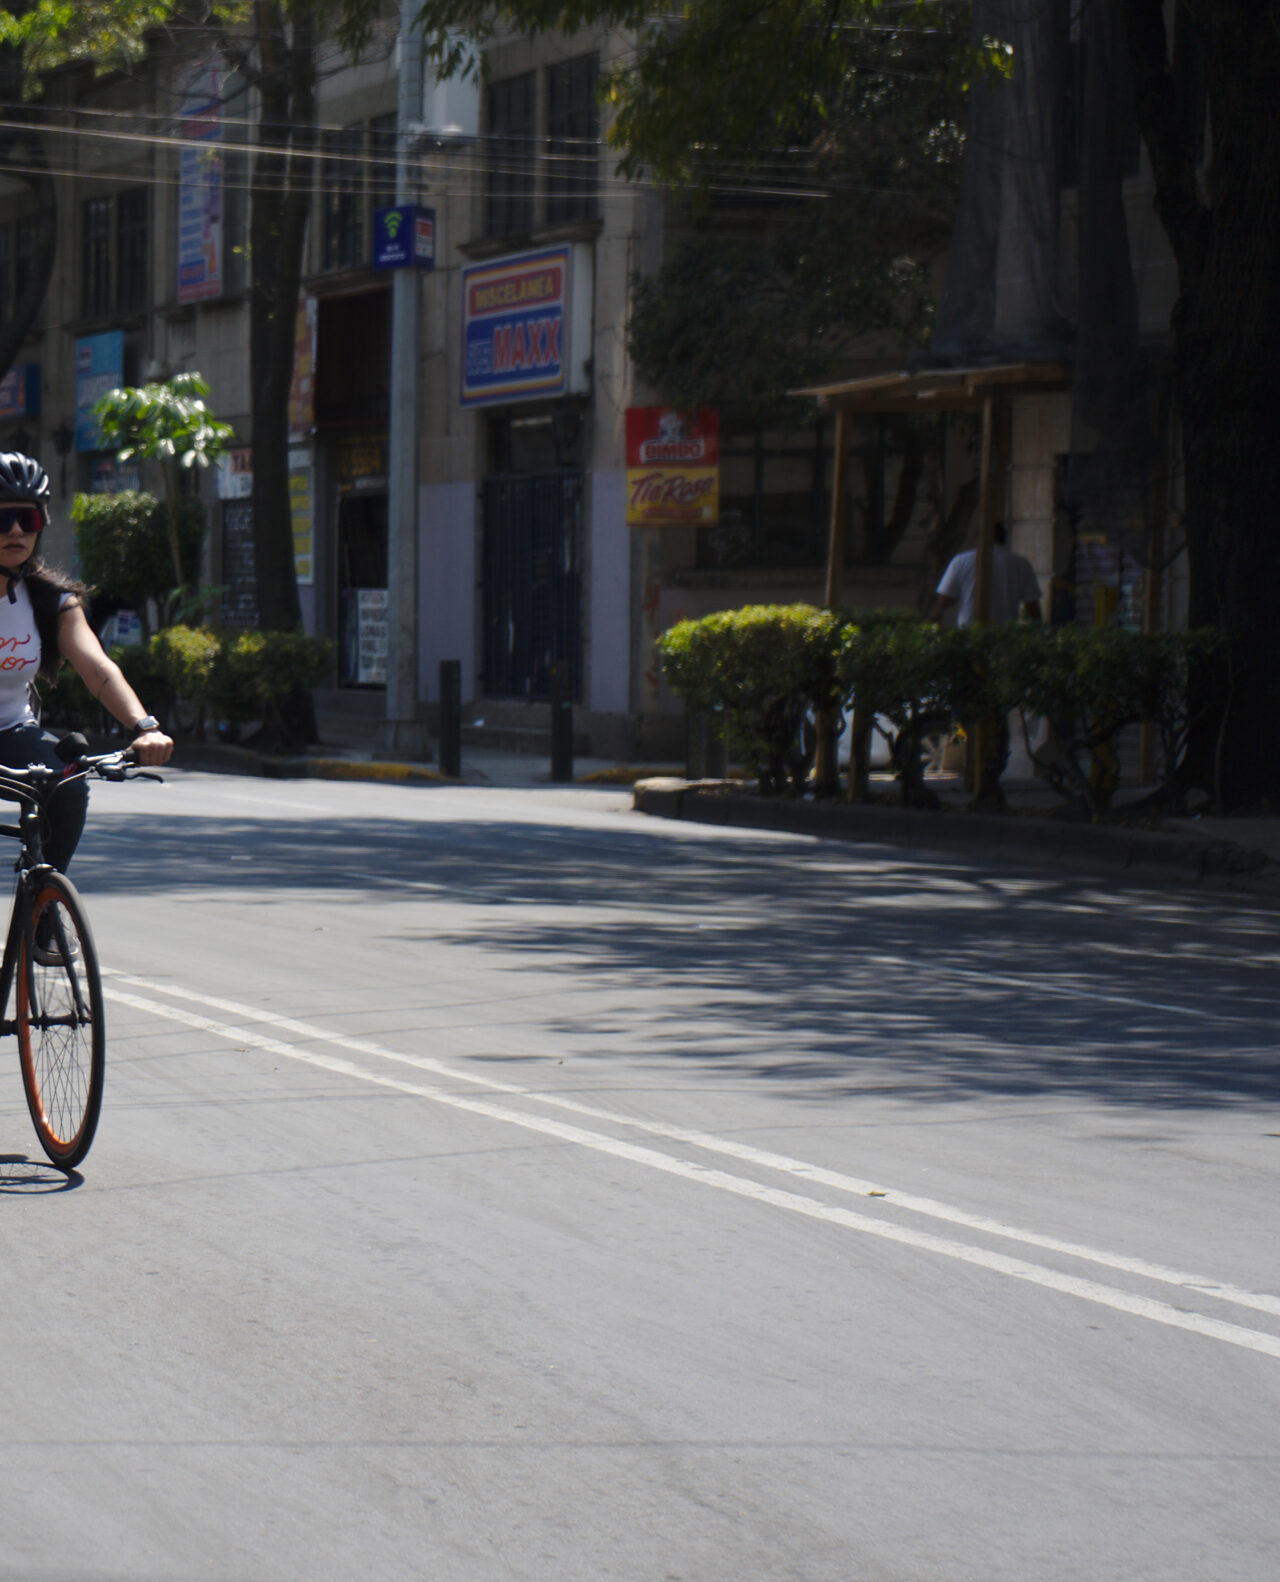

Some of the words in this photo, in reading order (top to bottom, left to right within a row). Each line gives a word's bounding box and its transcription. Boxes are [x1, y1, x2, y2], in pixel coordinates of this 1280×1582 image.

[474, 272, 554, 311] MISCELANEA
[493, 316, 560, 372] MAXX
[645, 443, 701, 460] BIMBO
